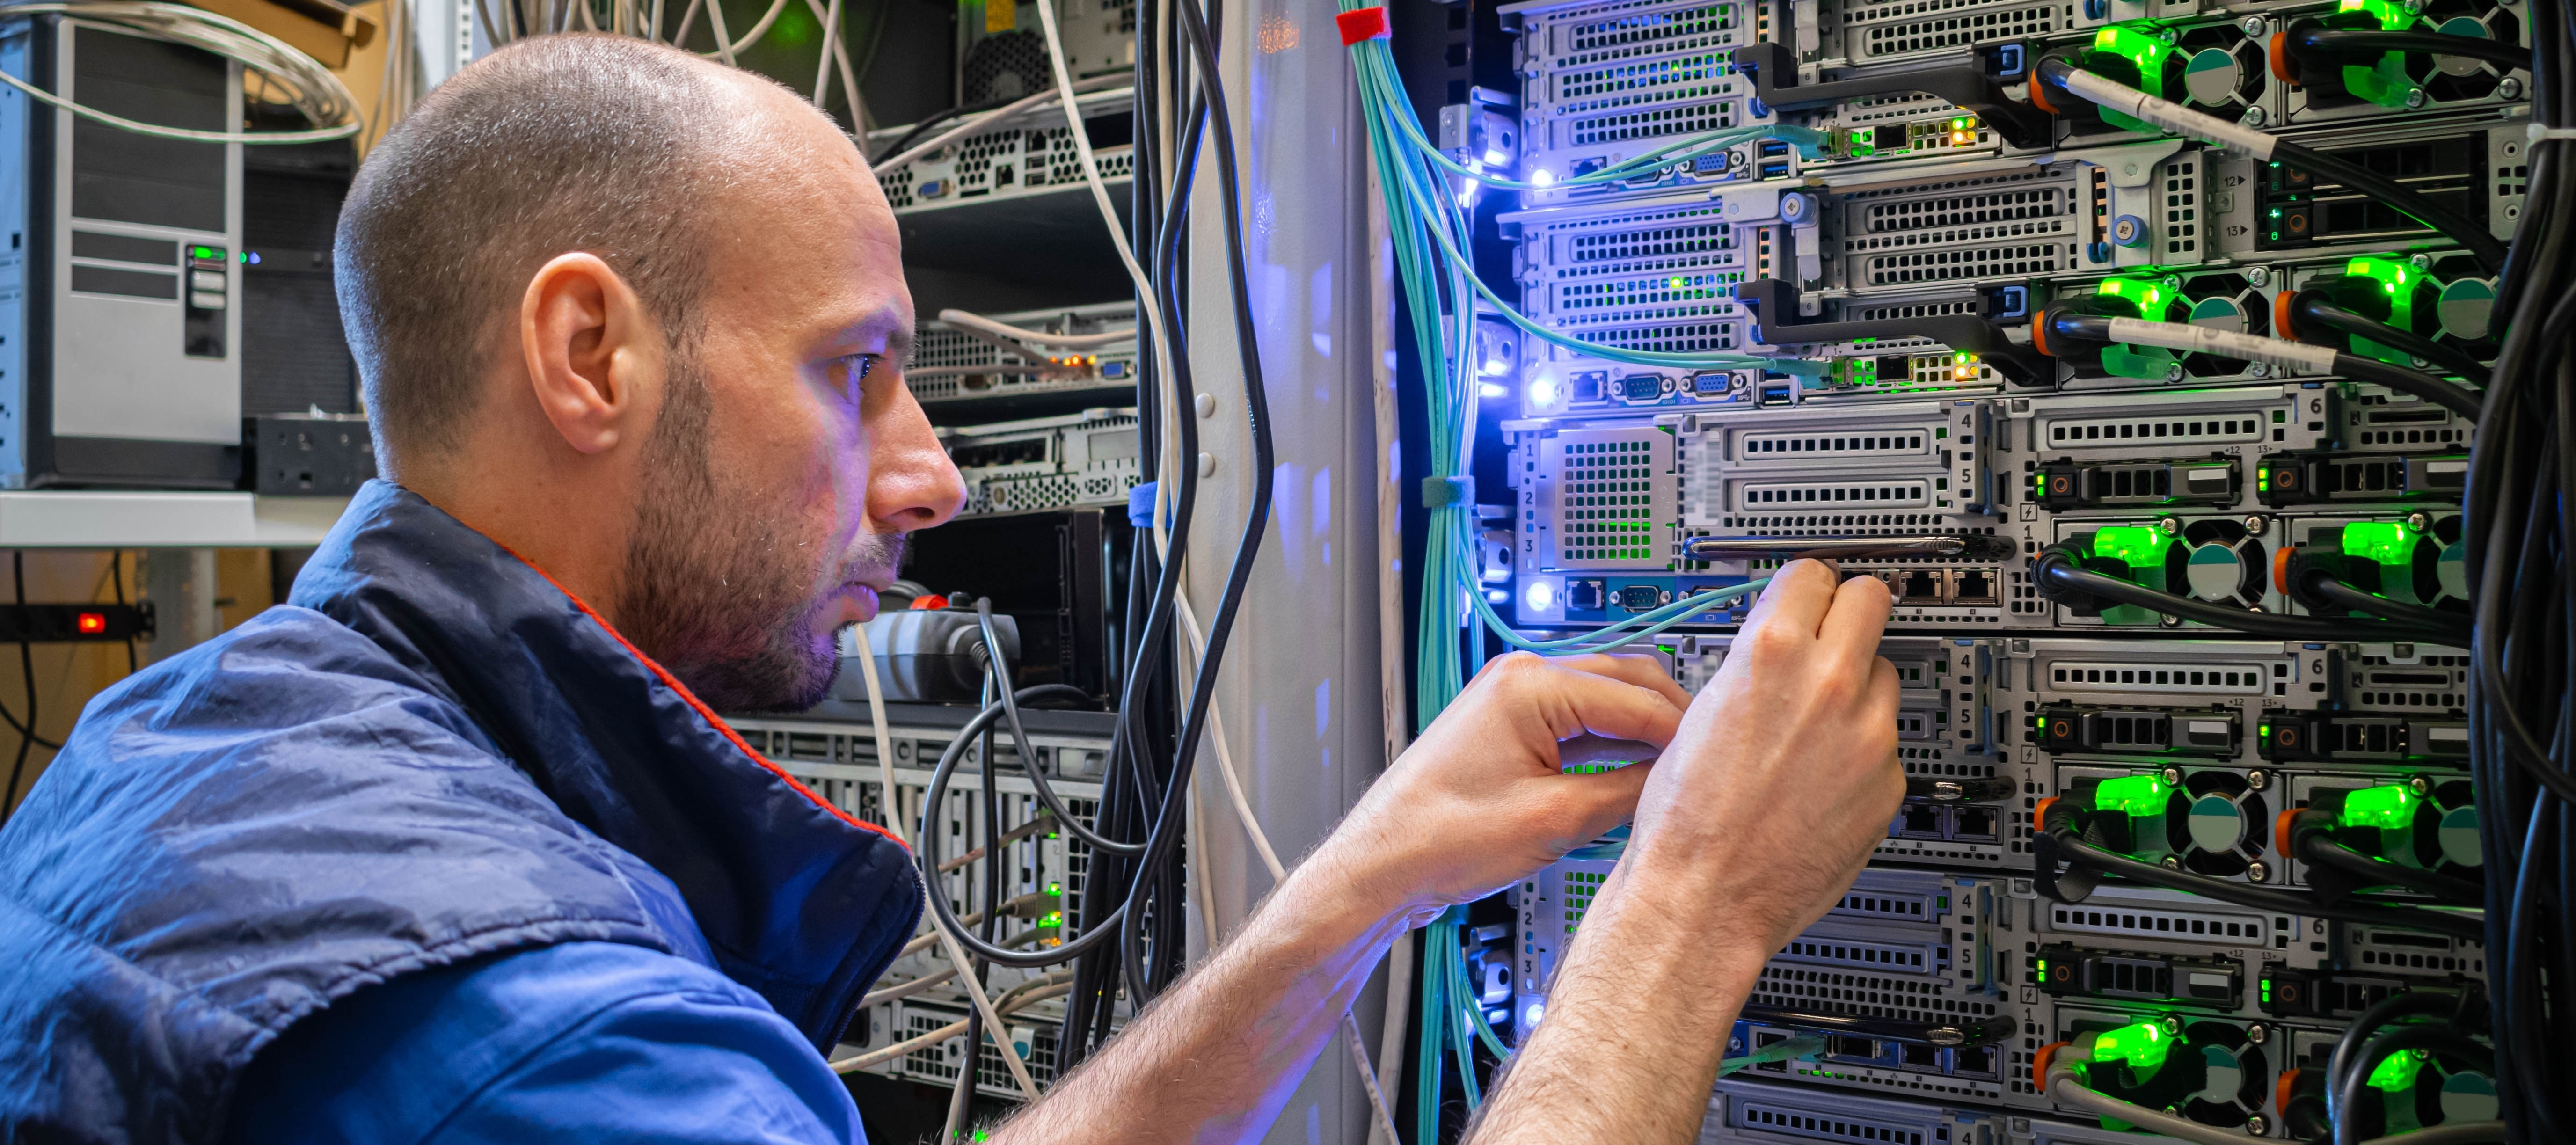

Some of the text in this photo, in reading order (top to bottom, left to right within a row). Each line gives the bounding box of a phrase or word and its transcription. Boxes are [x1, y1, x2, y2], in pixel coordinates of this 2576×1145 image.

[2224, 176, 2236, 187] 12
[2226, 226, 2237, 236] 13
[2310, 398, 2321, 414] 6
[1962, 414, 1971, 428] 4
[1526, 444, 1533, 456] 1
[1962, 469, 1970, 483] 5
[1526, 492, 1532, 504] 2
[2024, 525, 2033, 540] 1
[1526, 540, 1532, 552] 3
[1961, 654, 1970, 668] 4
[2312, 659, 2323, 674] 6
[1962, 709, 1970, 723] 5
[2025, 767, 2033, 782] 1
[1962, 894, 1972, 908] 4
[1525, 912, 1532, 925] 2
[2313, 919, 2324, 934] 6
[1962, 949, 1971, 963] 5
[1525, 960, 1531, 973] 3
[2025, 1007, 2034, 1022] 1
[1962, 1132, 1972, 1145] 4
